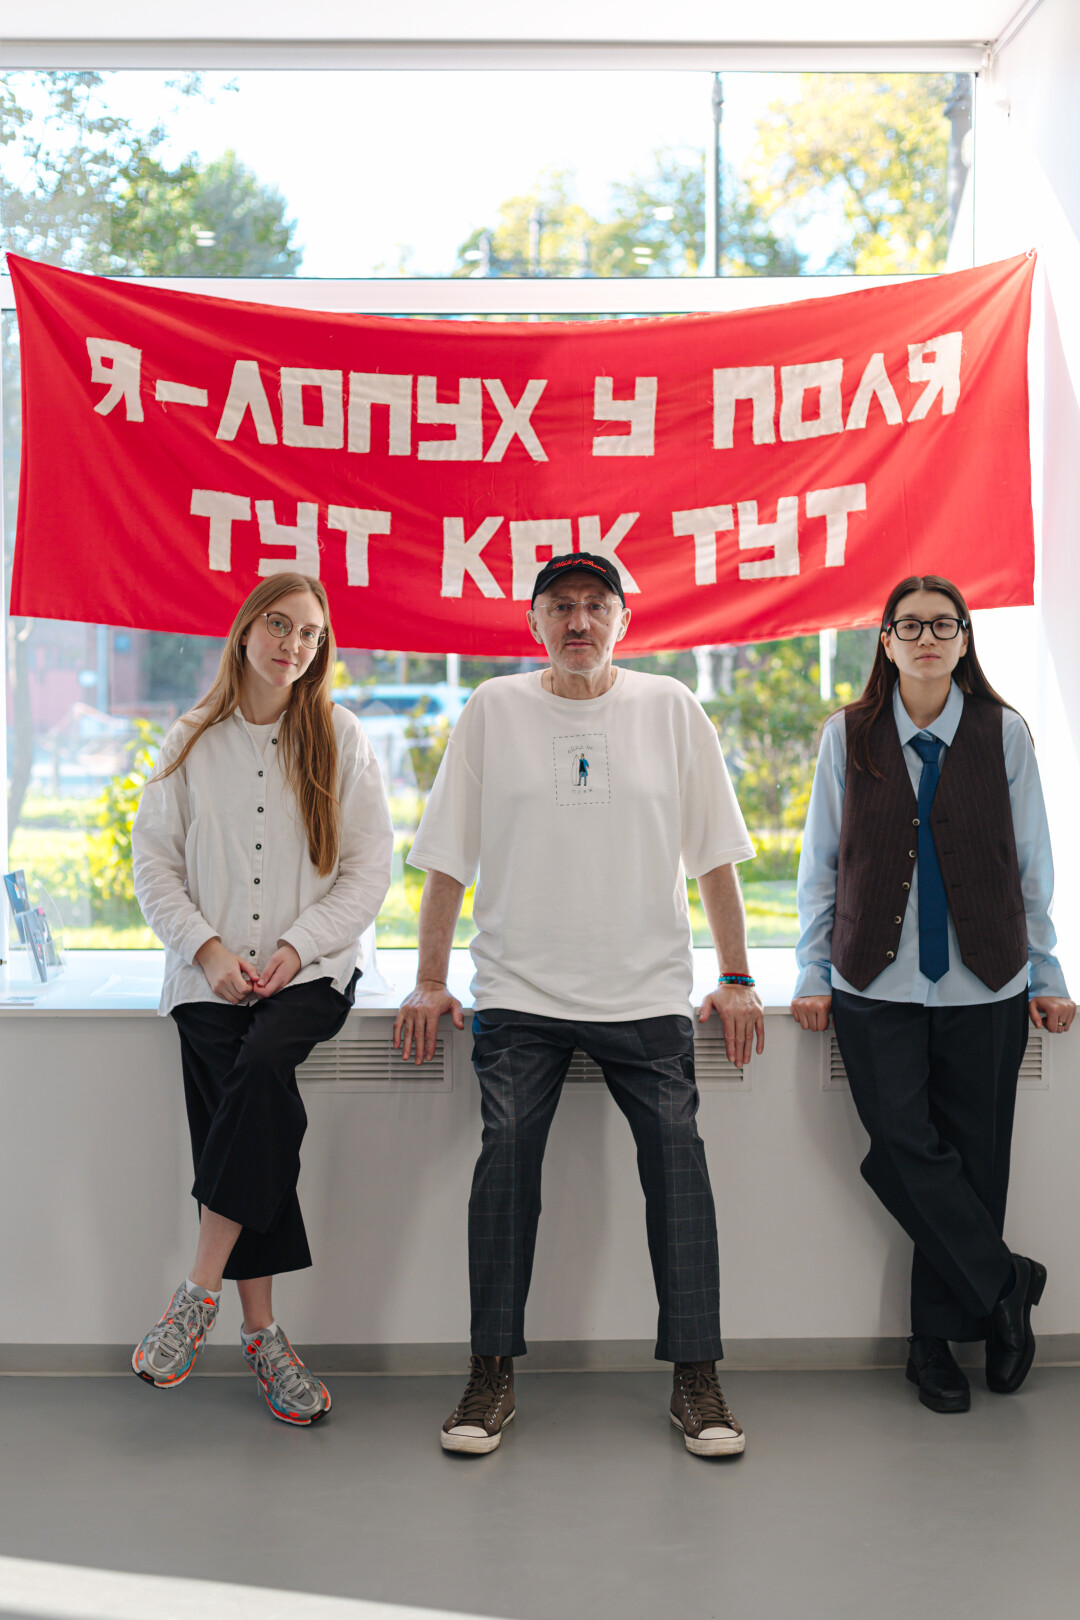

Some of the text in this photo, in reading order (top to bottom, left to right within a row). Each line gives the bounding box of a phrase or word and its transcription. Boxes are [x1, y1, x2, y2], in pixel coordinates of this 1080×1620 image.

[592, 376, 658, 457] У
[712, 331, 963, 450] ПОЛЯ
[190, 488, 391, 588] ТУТ
[671, 482, 867, 586] ТУТ
